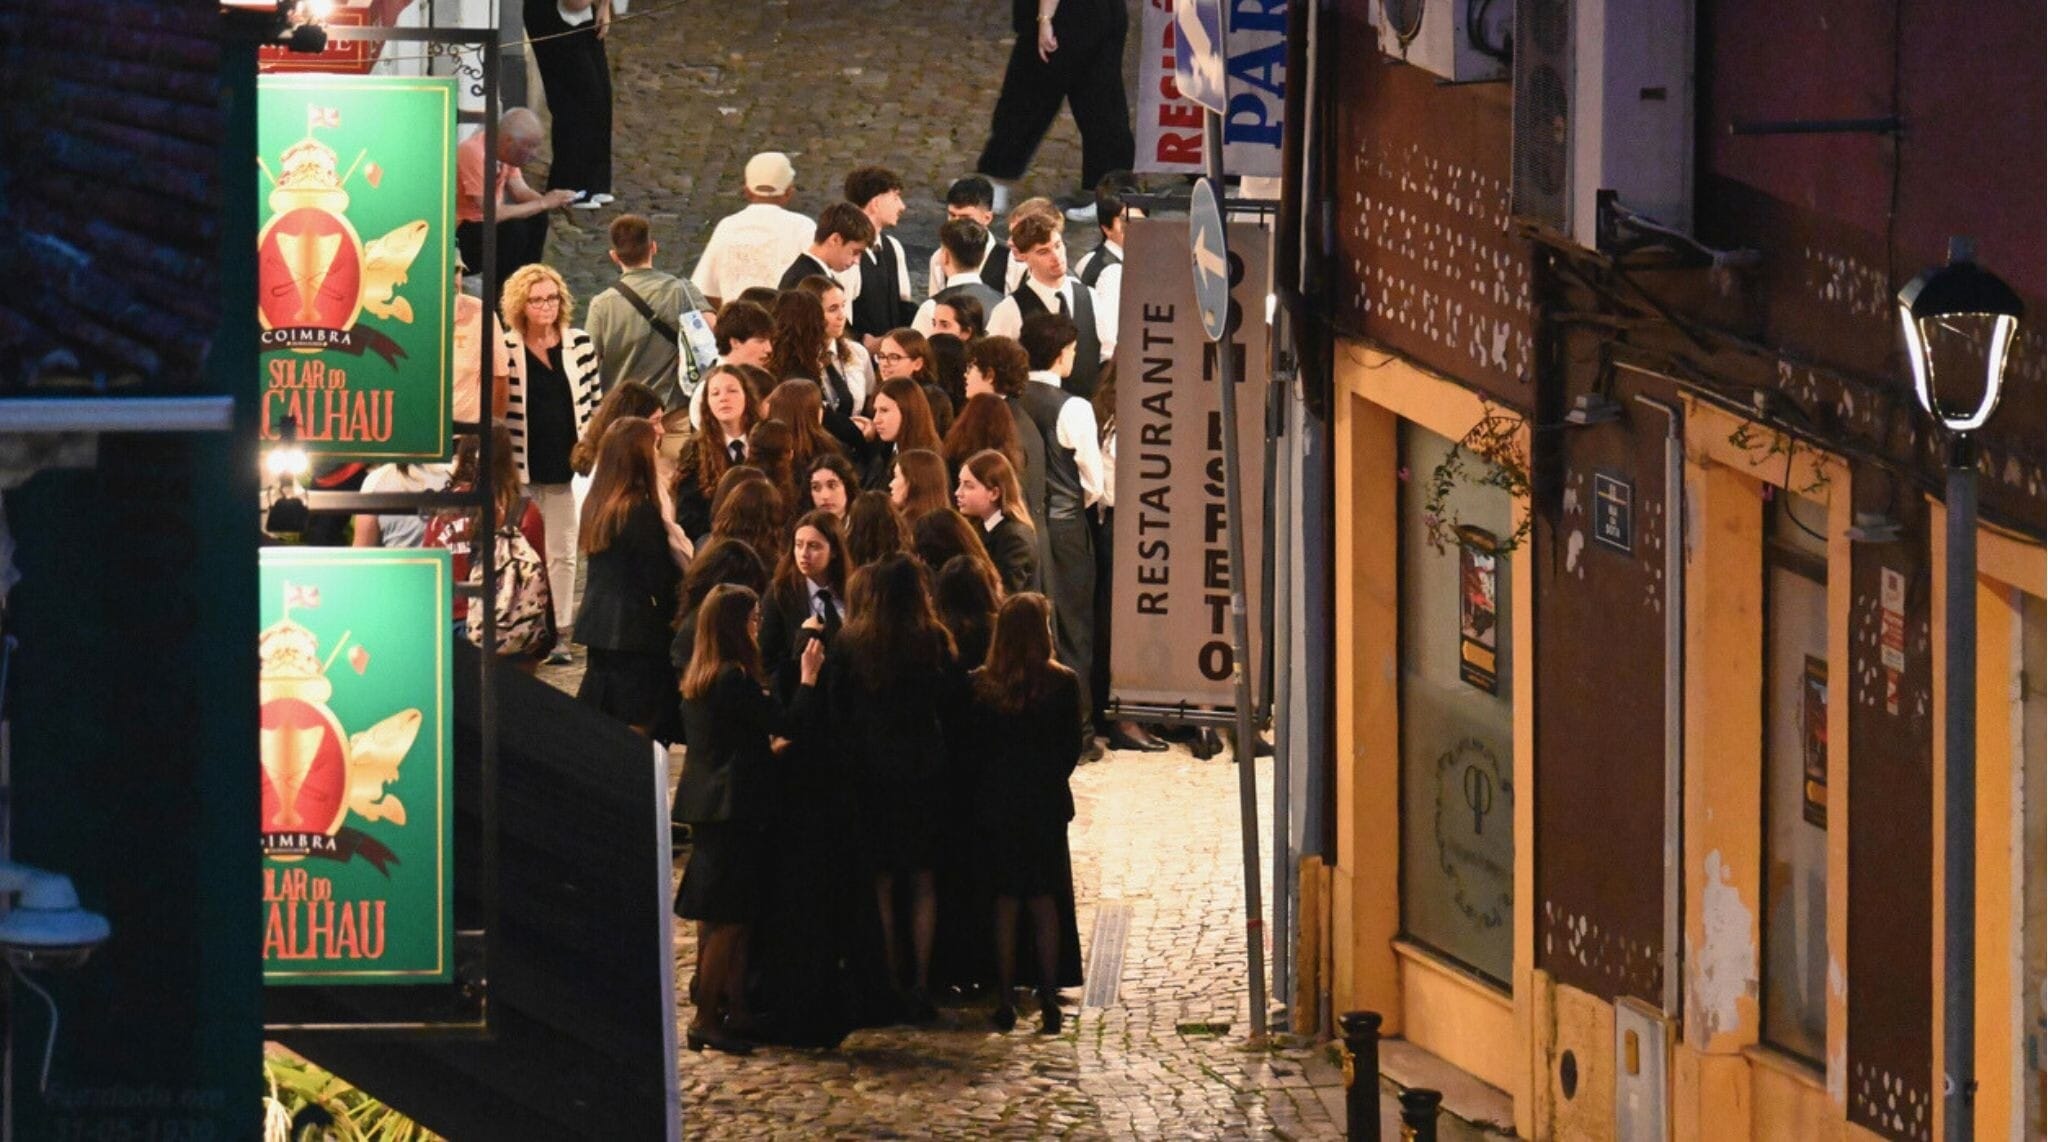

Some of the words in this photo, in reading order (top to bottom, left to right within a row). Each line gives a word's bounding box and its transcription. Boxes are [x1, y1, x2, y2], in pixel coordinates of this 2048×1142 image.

[261, 329, 351, 345] COIMBRA
[268, 359, 325, 389] SOLAR
[260, 388, 395, 442] CALHAU
[1137, 303, 1174, 615] RESTAURANTE
[261, 834, 337, 850] IMBRA
[262, 900, 386, 959] ALHAU
